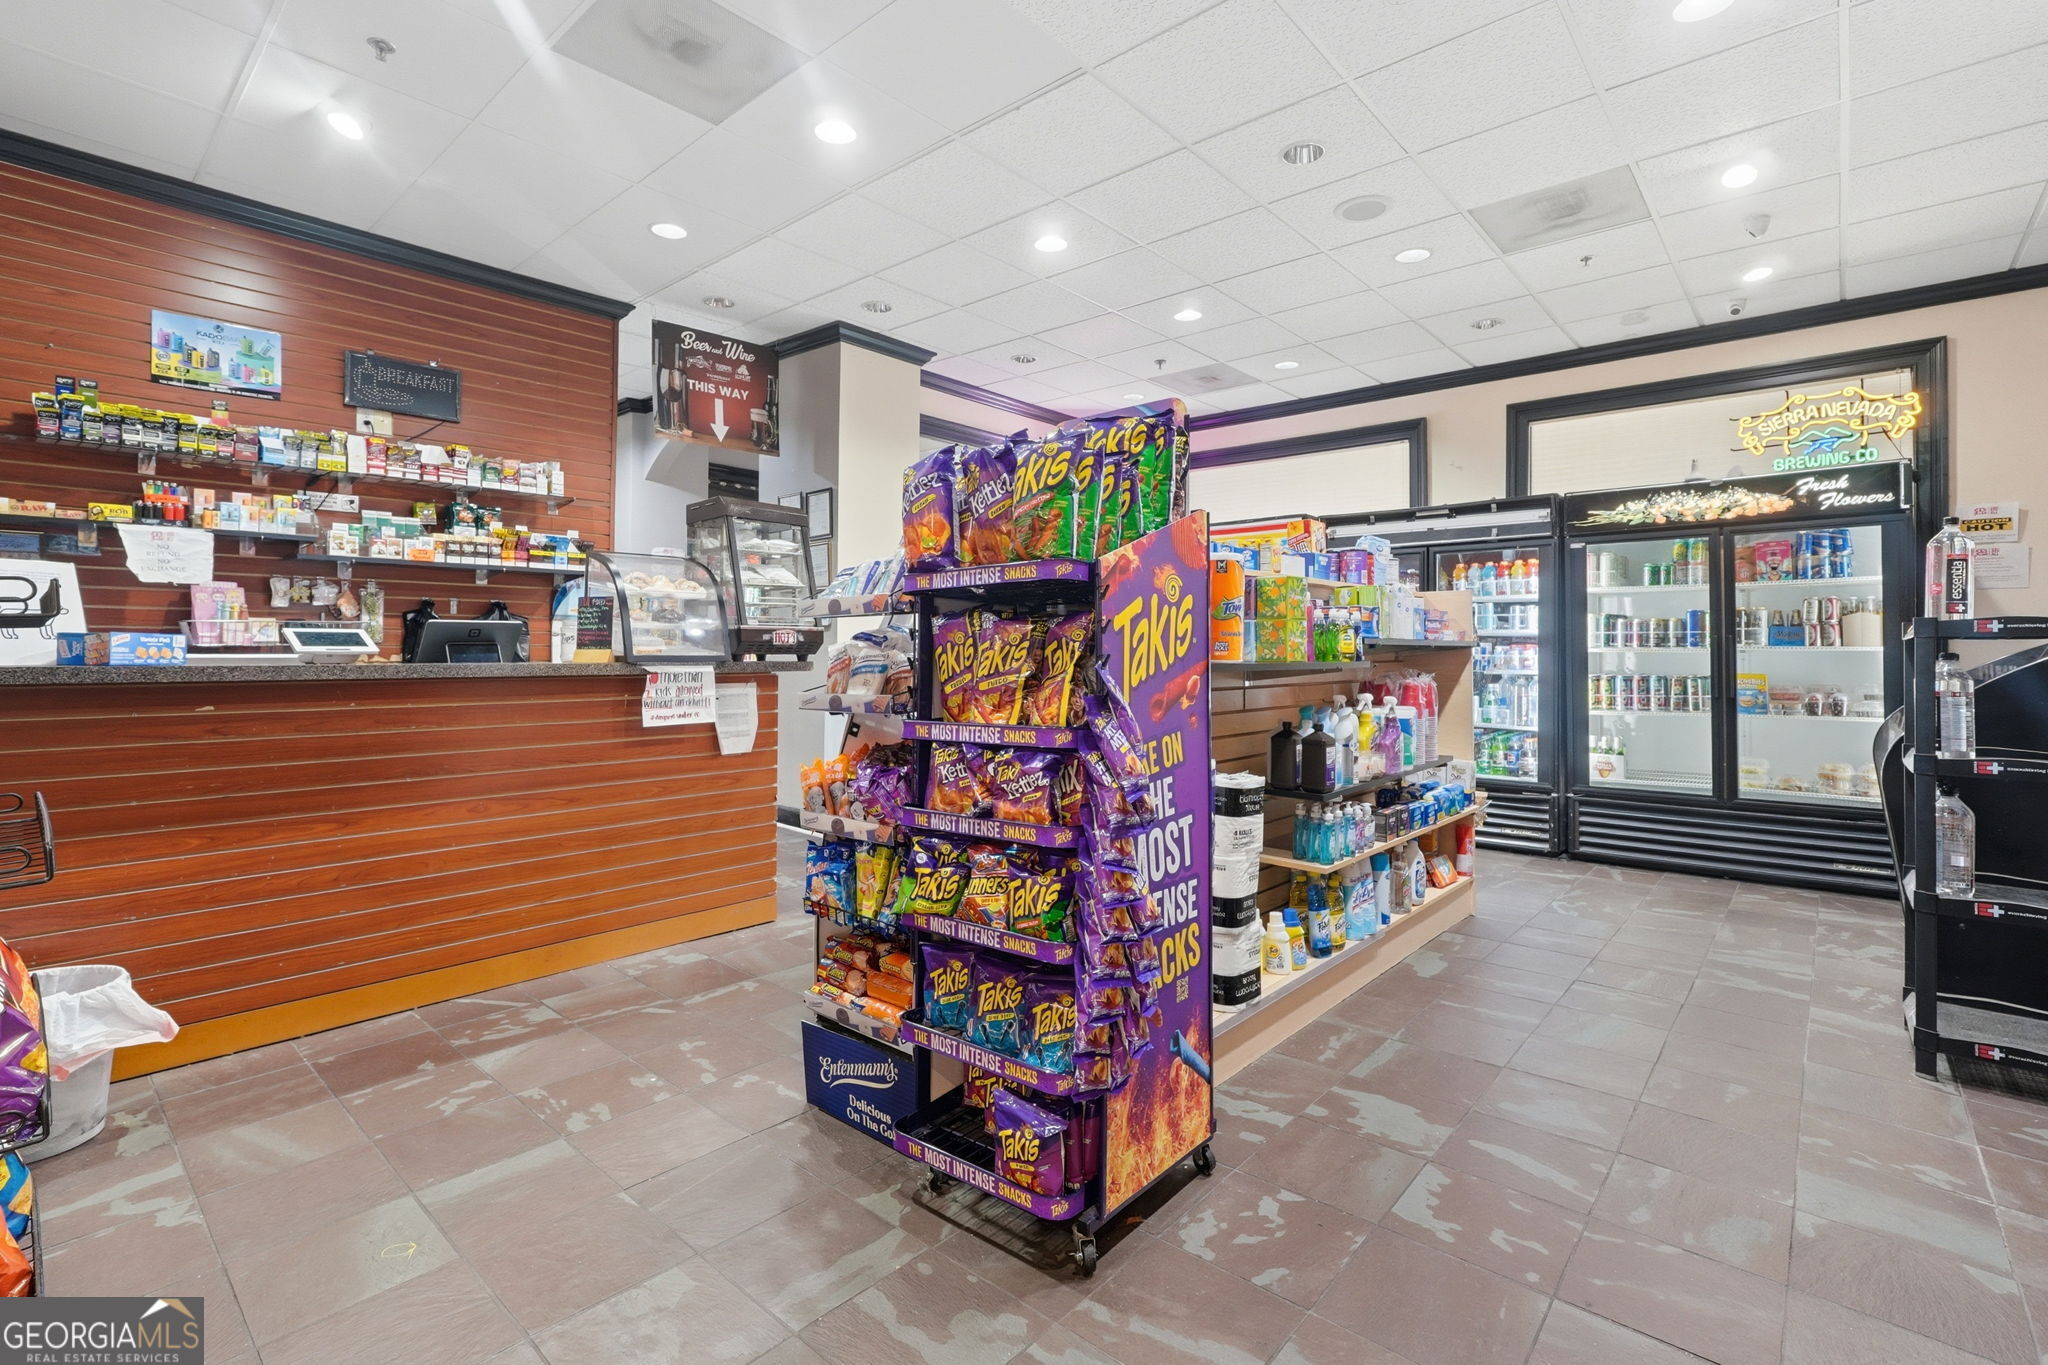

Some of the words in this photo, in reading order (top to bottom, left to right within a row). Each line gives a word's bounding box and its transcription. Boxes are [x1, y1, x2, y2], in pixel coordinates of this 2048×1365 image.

[681, 331, 712, 352] Beer
[721, 340, 755, 362] Wine
[377, 366, 455, 393] BREAKFAST
[687, 378, 716, 394] THIS
[719, 385, 749, 400] WAY
[1758, 405, 1820, 437] SIERRA
[1820, 400, 1897, 420] NEVADA
[1773, 450, 1850, 472] BREWING
[1796, 474, 1849, 495] Fresh
[1817, 491, 1896, 511] Flowers
[1966, 523, 2007, 532] HOT
[916, 576, 930, 588] THE
[932, 571, 959, 588] MOST
[959, 568, 1001, 586] INTENSE
[1004, 565, 1037, 581] SNACKS
[1055, 563, 1073, 579] Takis
[1952, 561, 1963, 599] essentia
[935, 638, 974, 685] Takis
[975, 640, 1030, 678] Takis
[1113, 590, 1193, 703] Takis
[915, 725, 929, 738] THE
[931, 724, 958, 741] MOST
[959, 726, 1001, 744] INTENSE
[1003, 729, 1036, 744] SNACKS
[1054, 730, 1073, 746] Takis
[1163, 731, 1184, 770] ON
[938, 763, 968, 784] Kett
[1002, 771, 1049, 801] Kettlez
[1149, 777, 1176, 818] HE
[913, 813, 928, 827] THE
[930, 814, 957, 833] MOST
[958, 817, 1000, 838] INTENSE
[1003, 825, 1036, 842] SNACKS
[1054, 829, 1073, 847] Takis
[911, 868, 961, 901] Takis
[1009, 877, 1062, 918] Takis
[913, 914, 927, 929] THE
[929, 919, 957, 939] MOST
[958, 924, 1000, 948] INTENSE
[1003, 935, 1036, 956] SNACKS
[1054, 945, 1073, 962] Takis
[930, 967, 968, 1000] Takis
[977, 980, 1024, 1017] Takis
[1032, 1002, 1077, 1040] Takis
[819, 1056, 898, 1084] Entenmann's
[914, 1030, 929, 1044] THE
[930, 1036, 958, 1058] MOST
[959, 1045, 1002, 1071] INTENSE
[1004, 1063, 1038, 1084] SNACKS
[1056, 1075, 1075, 1092] Takis
[846, 1107, 860, 1123] On
[862, 1113, 879, 1133] The
[849, 1094, 892, 1125] Delicious
[999, 1129, 1040, 1162] Takis
[907, 1141, 922, 1158] THE
[924, 1148, 951, 1173] MOST
[952, 1157, 995, 1193] INTENSE
[998, 1182, 1032, 1209] SNACKS
[1051, 1201, 1069, 1218] Takis
